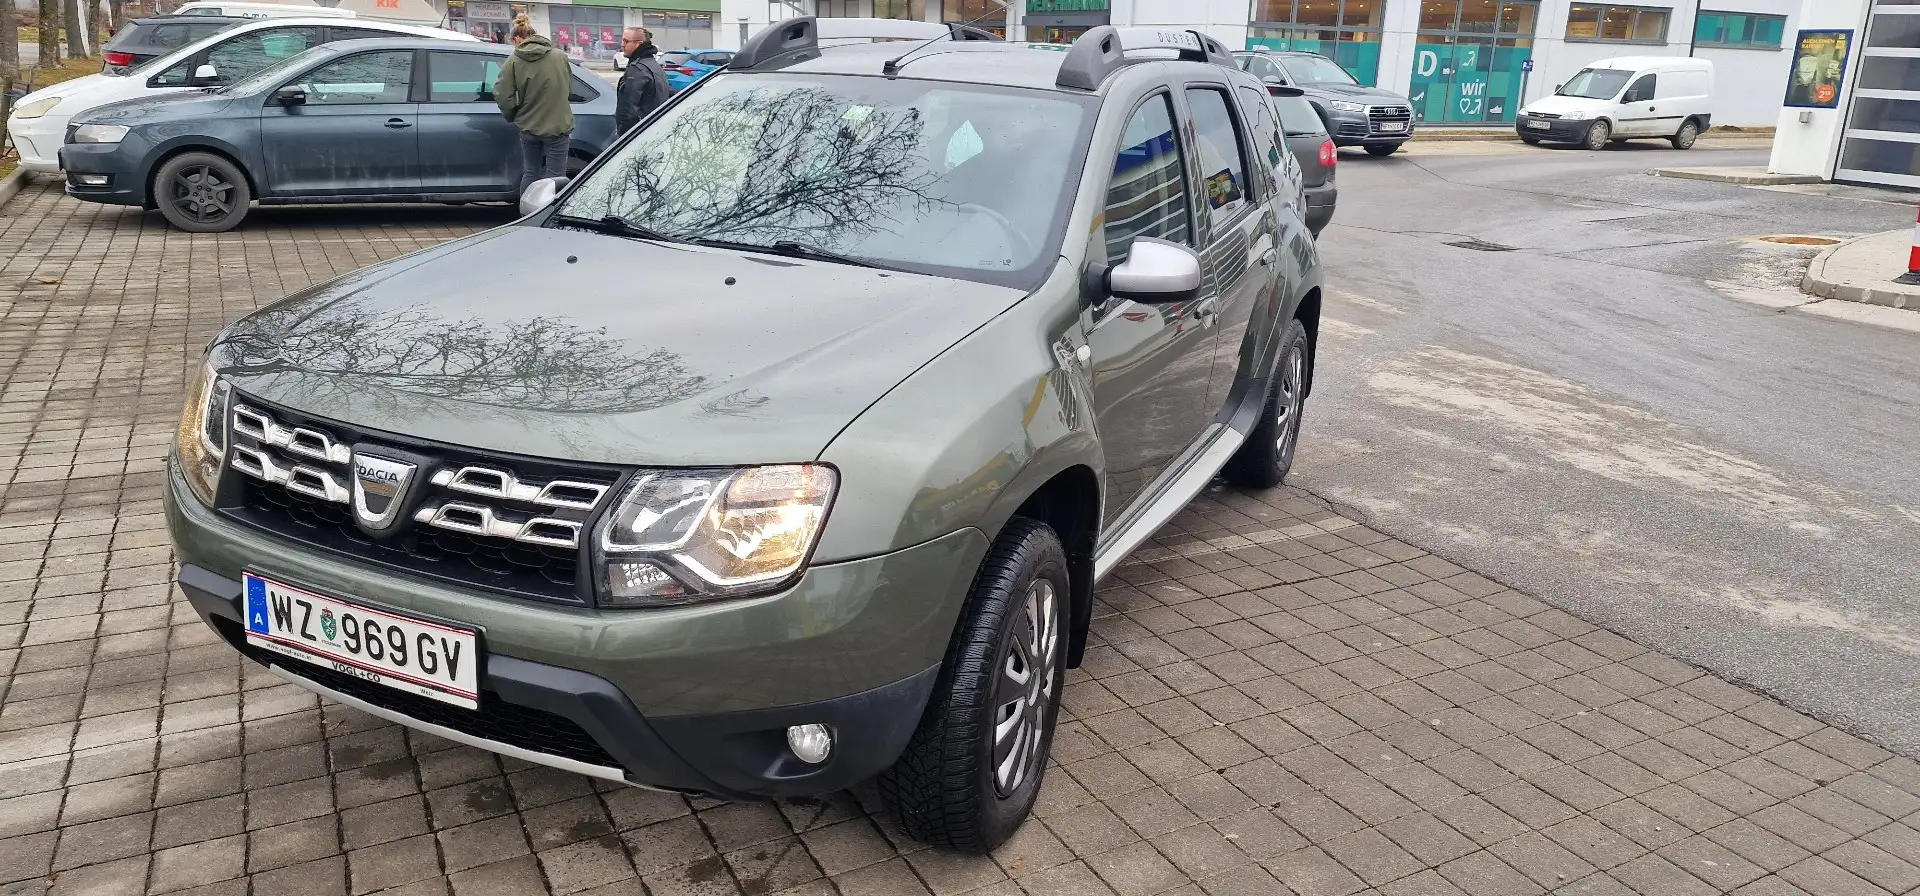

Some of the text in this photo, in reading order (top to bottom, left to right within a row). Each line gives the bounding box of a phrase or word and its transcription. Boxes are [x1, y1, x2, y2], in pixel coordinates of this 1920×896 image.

[1157, 32, 1197, 47] DUSTER
[1461, 78, 1486, 96] wir
[358, 465, 398, 482] DACIA
[254, 612, 264, 626] A
[270, 590, 461, 682] WZ 969 GV
[331, 661, 381, 684] VOGL+CO
